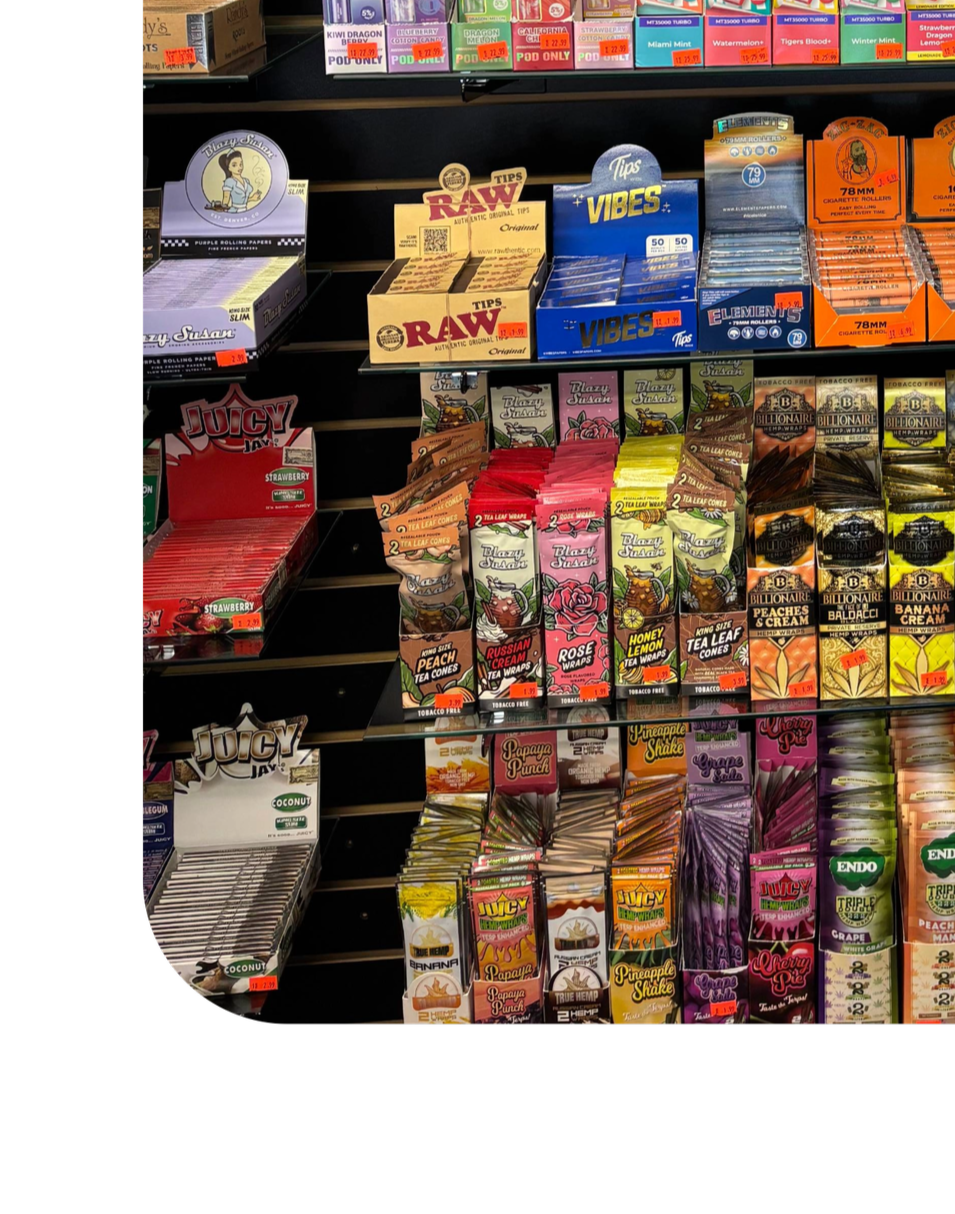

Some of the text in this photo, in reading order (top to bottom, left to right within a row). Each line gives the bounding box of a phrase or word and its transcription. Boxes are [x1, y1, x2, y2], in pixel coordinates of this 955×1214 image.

[347, 31, 382, 39] DRAGON
[712, 39, 764, 47] Watermelon+
[781, 37, 831, 46] Tigers Blood+
[926, 31, 953, 39] Dragon
[516, 51, 570, 62] POD ONLY
[717, 116, 790, 132] ELEMENTS
[827, 118, 888, 141] ZIG-ZAG
[202, 134, 276, 159] Blazy Susan
[609, 153, 641, 182] Tips
[494, 172, 522, 183] TIPS
[840, 187, 874, 196] 78MM
[426, 183, 522, 221] RAW
[587, 185, 662, 224] VIBES
[500, 223, 539, 232] Original
[186, 402, 292, 438] JUICY
[265, 472, 309, 482] STRAWBERRY
[753, 606, 809, 618] PEACHES
[828, 610, 878, 620] BALDACCI
[895, 604, 949, 615] BANANA
[756, 616, 809, 627] & CREAM
[629, 627, 664, 646] HONEY
[486, 639, 531, 659] RUSSIAN
[558, 643, 595, 663] ROSE
[628, 639, 663, 657] LEMON
[417, 652, 456, 673] PEACH
[491, 653, 526, 671] CREAM
[415, 664, 458, 684] TEA CONES
[196, 724, 301, 762] JUICY
[502, 740, 553, 765] Papaya
[506, 758, 550, 779] Punch
[271, 797, 311, 807] COCONUT
[837, 861, 877, 873] ENDO
[409, 959, 459, 971] BANANA
[752, 950, 812, 979] Cherry
[772, 972, 807, 996] Pie
